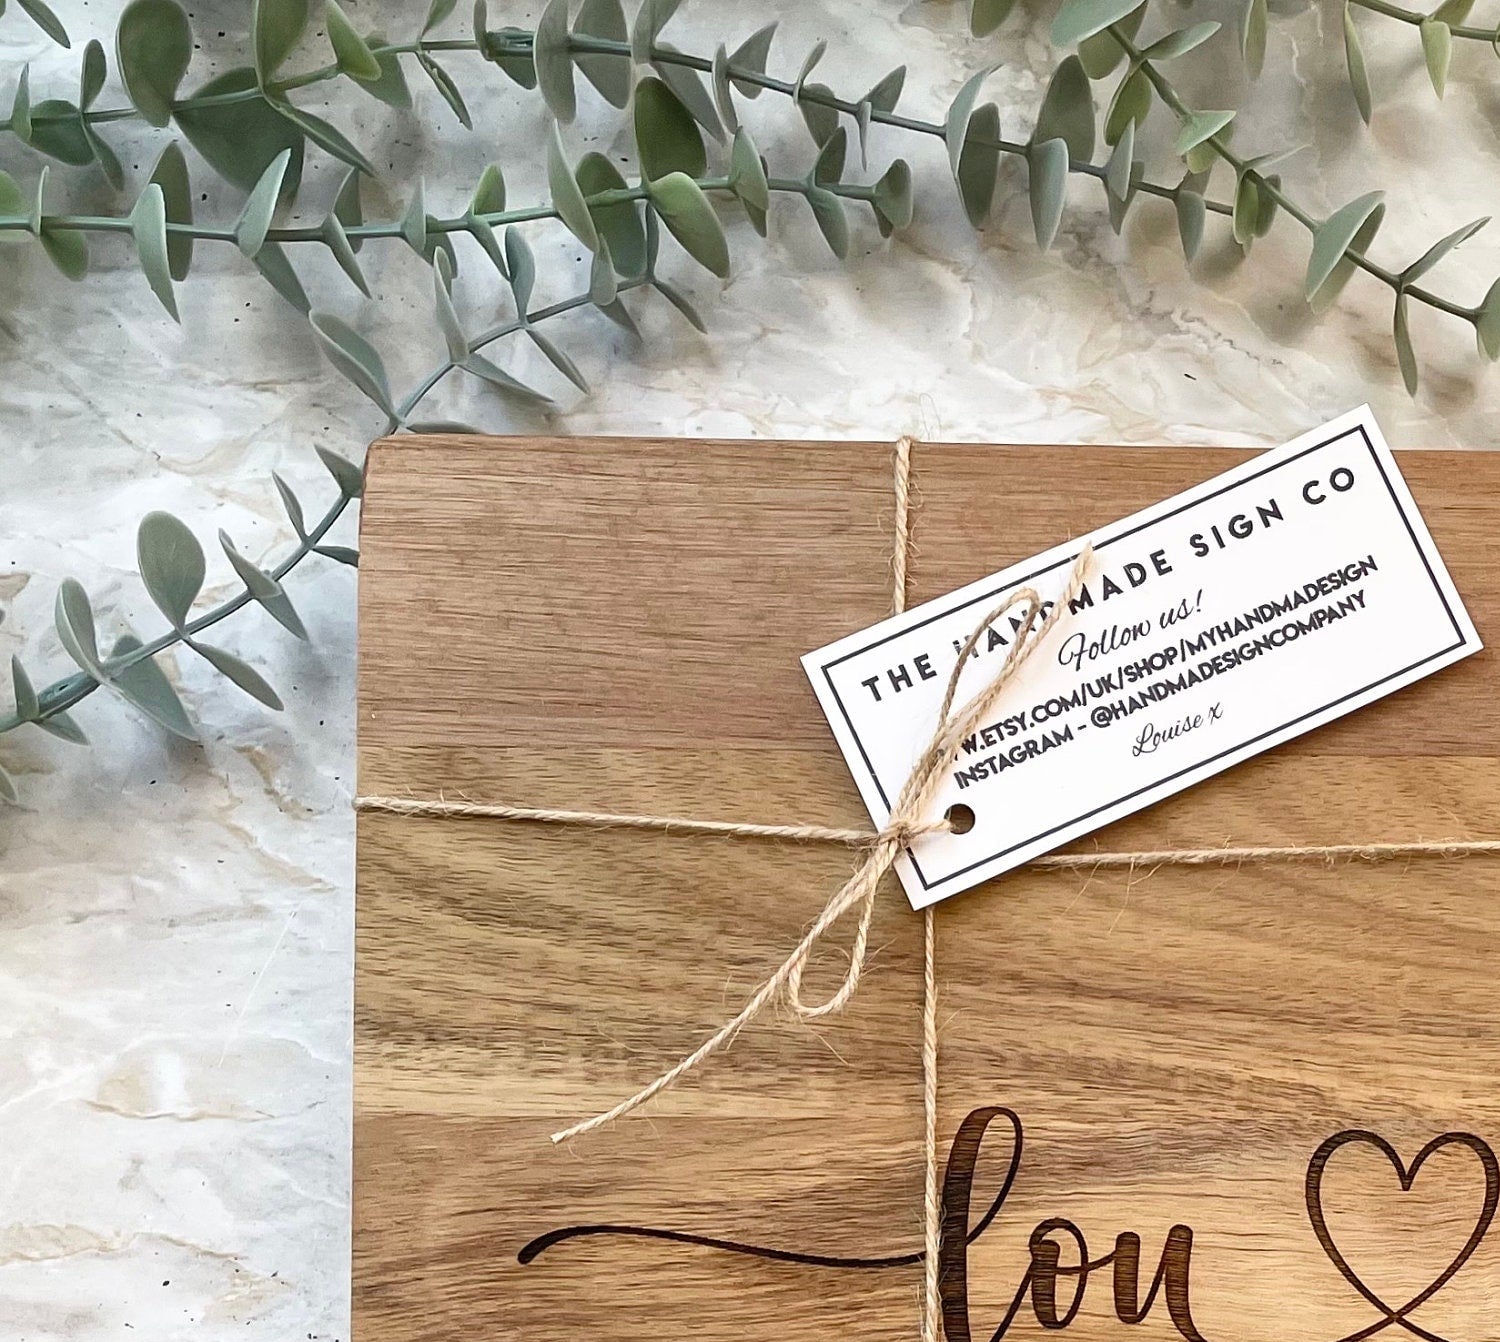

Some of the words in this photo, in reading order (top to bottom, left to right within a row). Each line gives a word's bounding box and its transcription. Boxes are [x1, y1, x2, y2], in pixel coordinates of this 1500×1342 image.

[861, 653, 937, 702] THE
[1189, 498, 1283, 557] SIGN
[1302, 467, 1355, 505] CO
[1058, 618, 1151, 672] Follow
[1158, 589, 1203, 629] us!
[953, 724, 1075, 789] INSTAGRAM
[1091, 589, 1367, 728] @HANDMADESIGNCOMPANY
[1132, 711, 1203, 758] Louise
